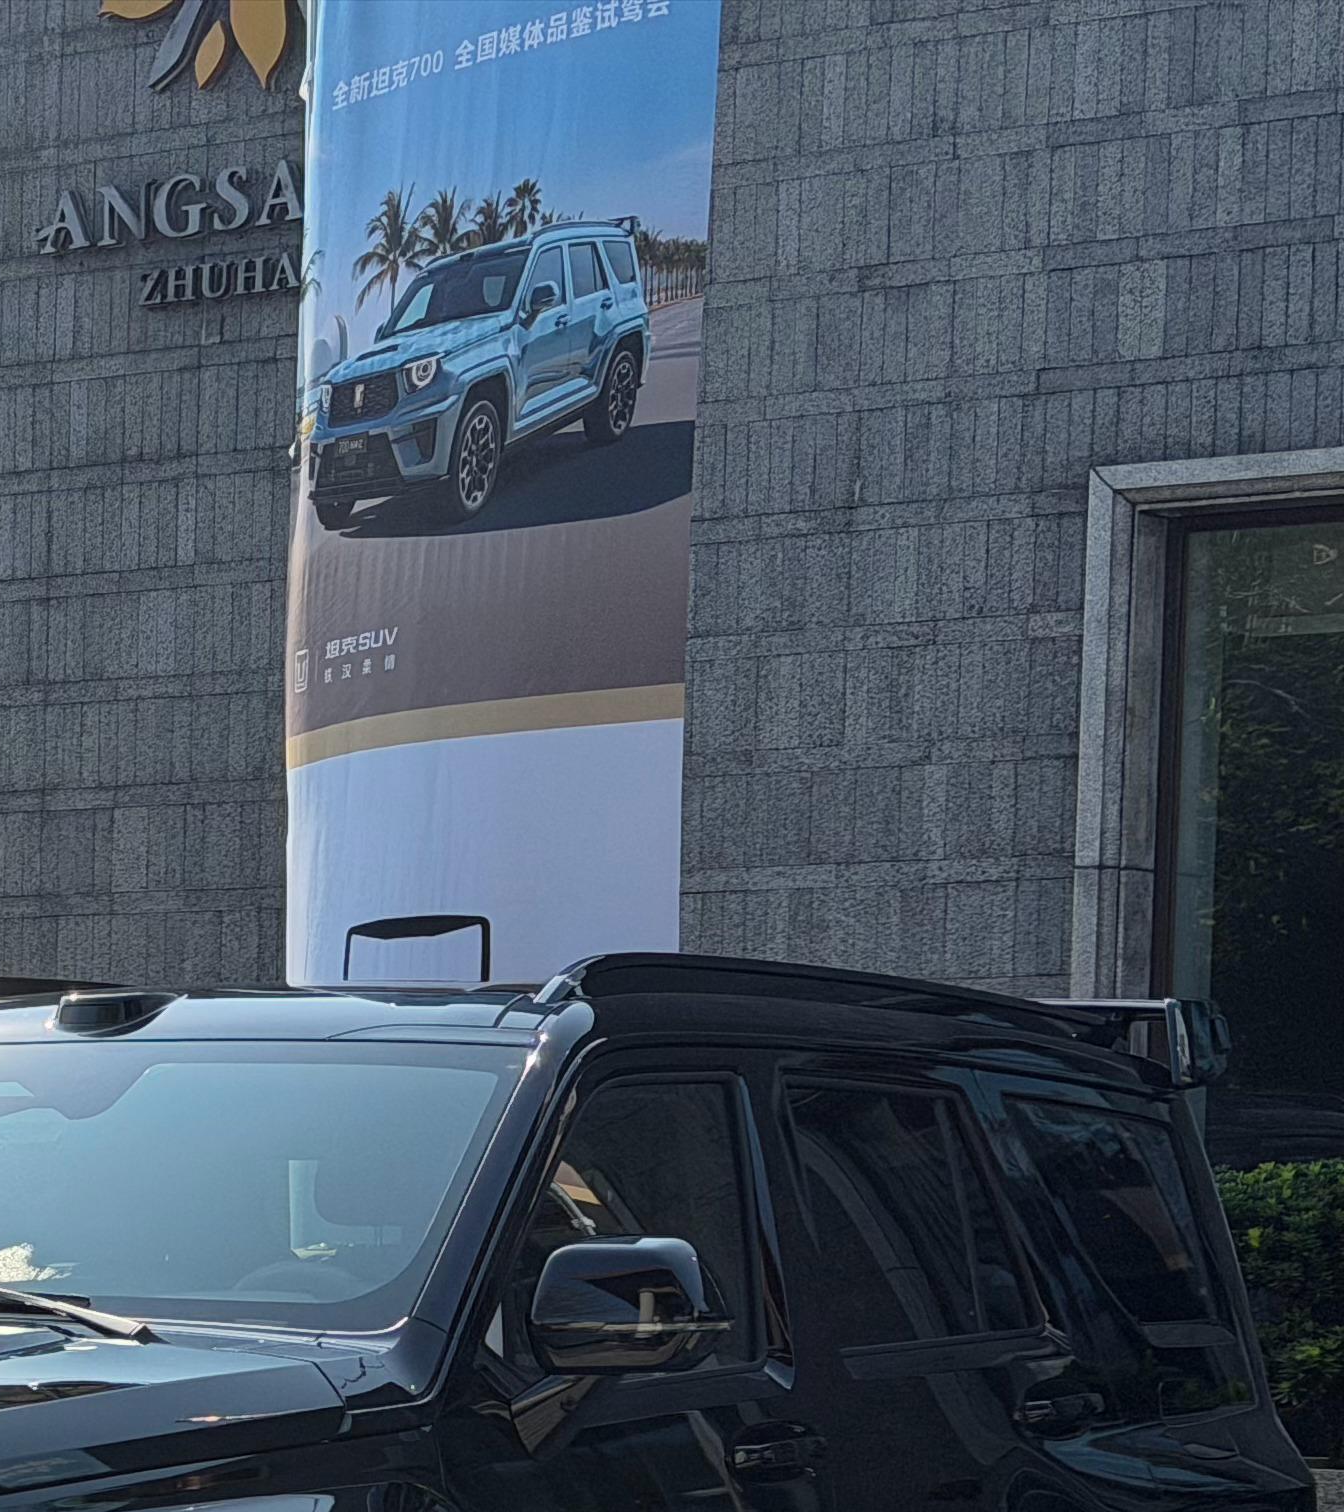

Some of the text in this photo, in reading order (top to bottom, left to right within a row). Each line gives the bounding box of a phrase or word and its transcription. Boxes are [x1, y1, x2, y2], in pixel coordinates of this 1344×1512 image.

[332, 0, 670, 111] 全新坦克700 全国媒体品鉴试驾会
[324, 626, 399, 660] 坦克SUV
